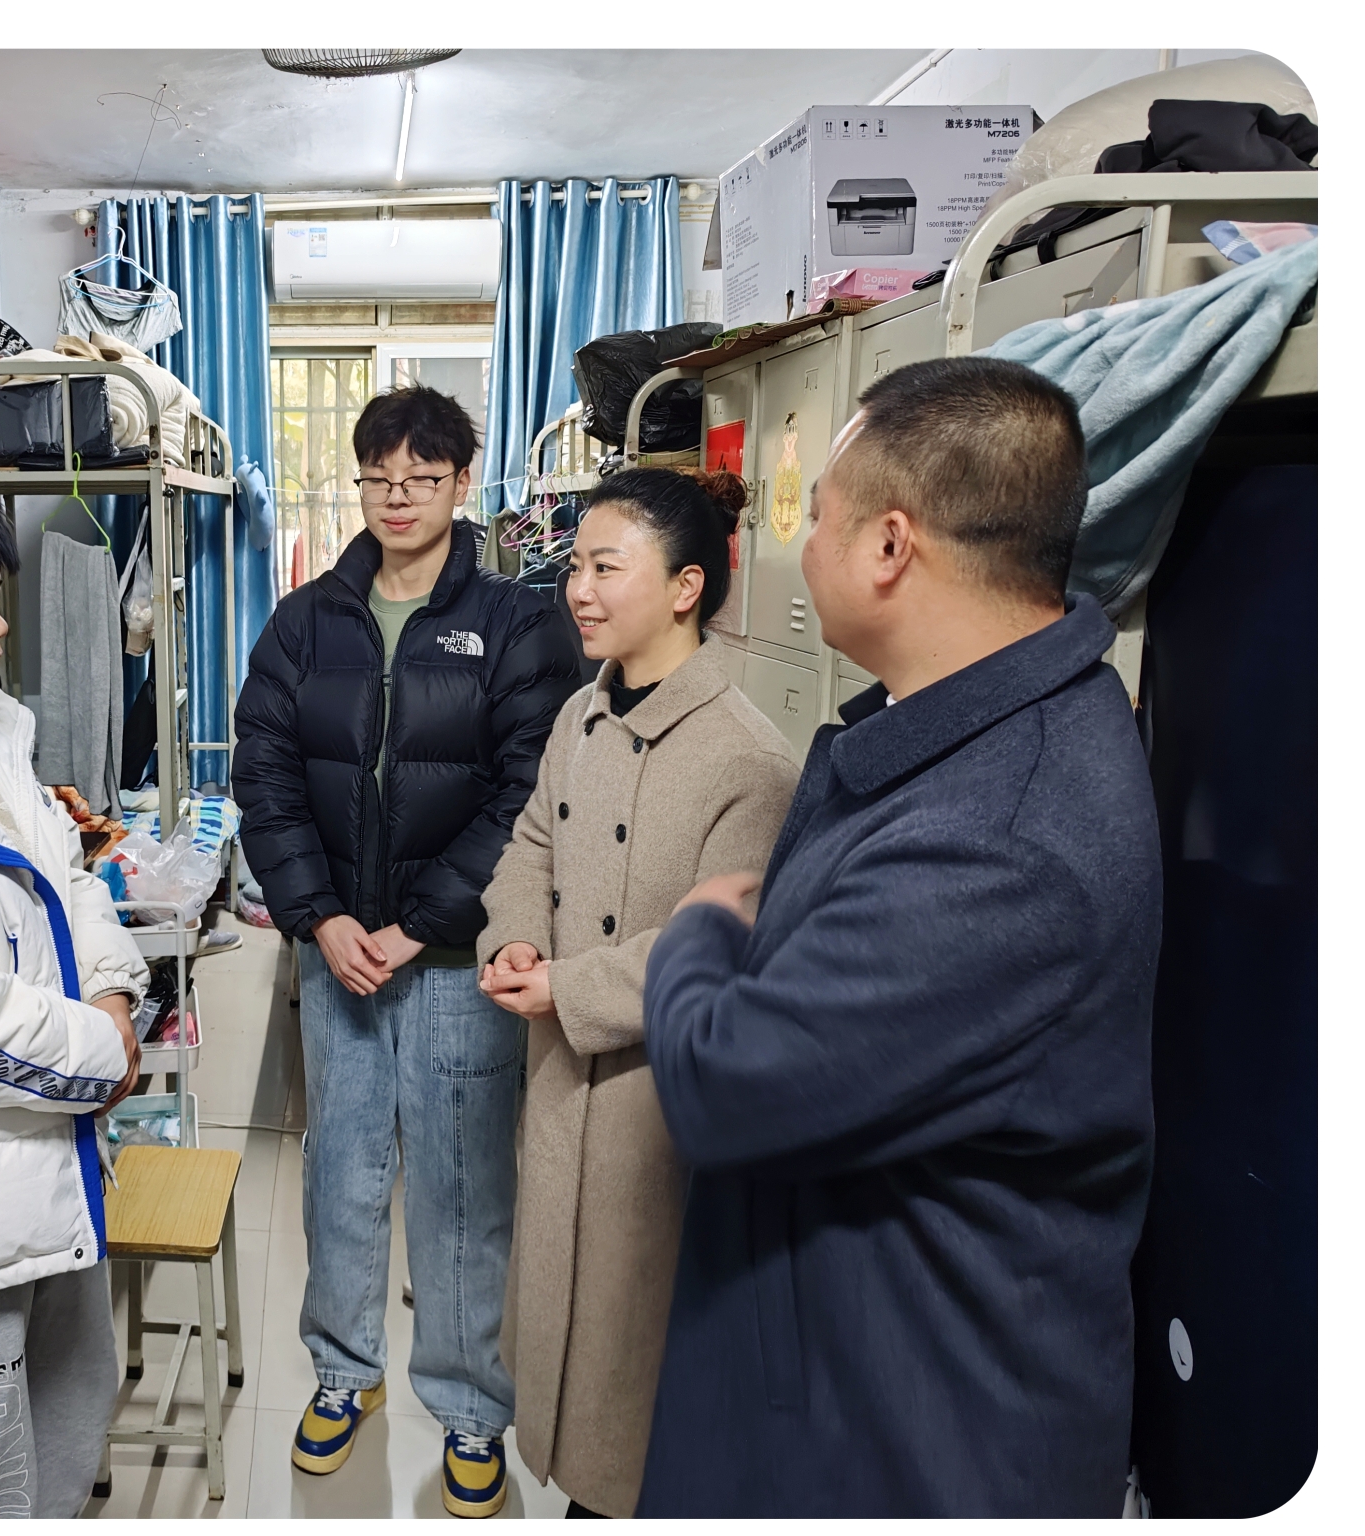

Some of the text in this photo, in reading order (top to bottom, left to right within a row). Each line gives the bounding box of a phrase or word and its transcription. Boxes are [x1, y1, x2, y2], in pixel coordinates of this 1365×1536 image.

[945, 118, 1020, 129] 激光多功能一体机
[987, 130, 1020, 138] M7206
[863, 273, 898, 285] Copier
[450, 630, 468, 640] THE
[437, 636, 468, 647] NORTH
[445, 645, 467, 654] FACE
